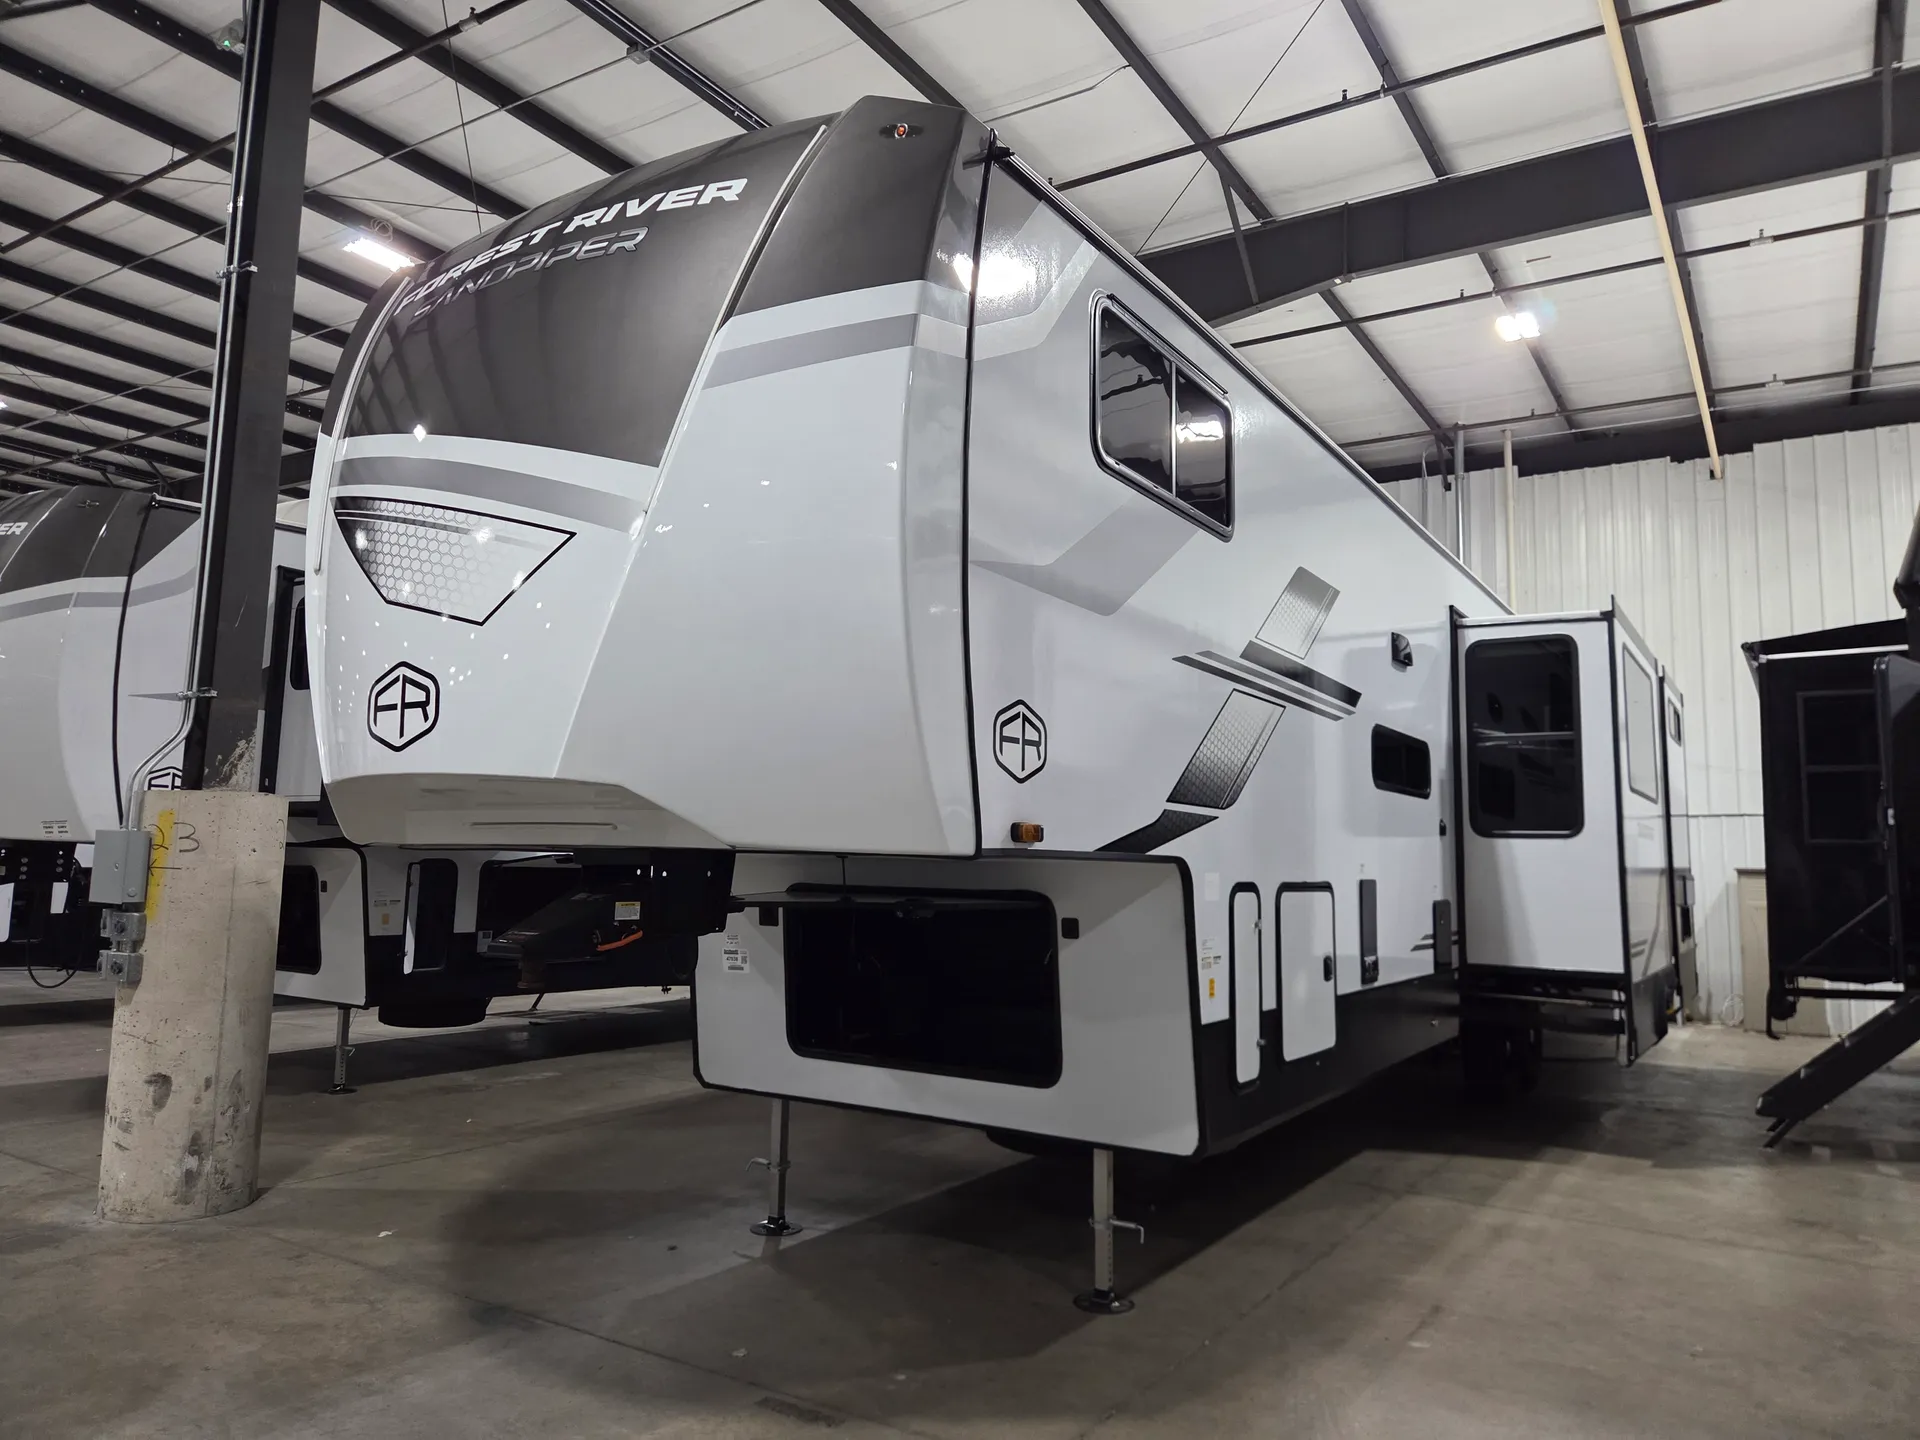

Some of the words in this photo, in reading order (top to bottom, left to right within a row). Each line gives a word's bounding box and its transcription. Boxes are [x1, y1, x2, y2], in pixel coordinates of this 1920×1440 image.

[394, 221, 563, 316] FOREST
[563, 178, 748, 234] RIVER
[410, 226, 649, 324] SANDPIPER
